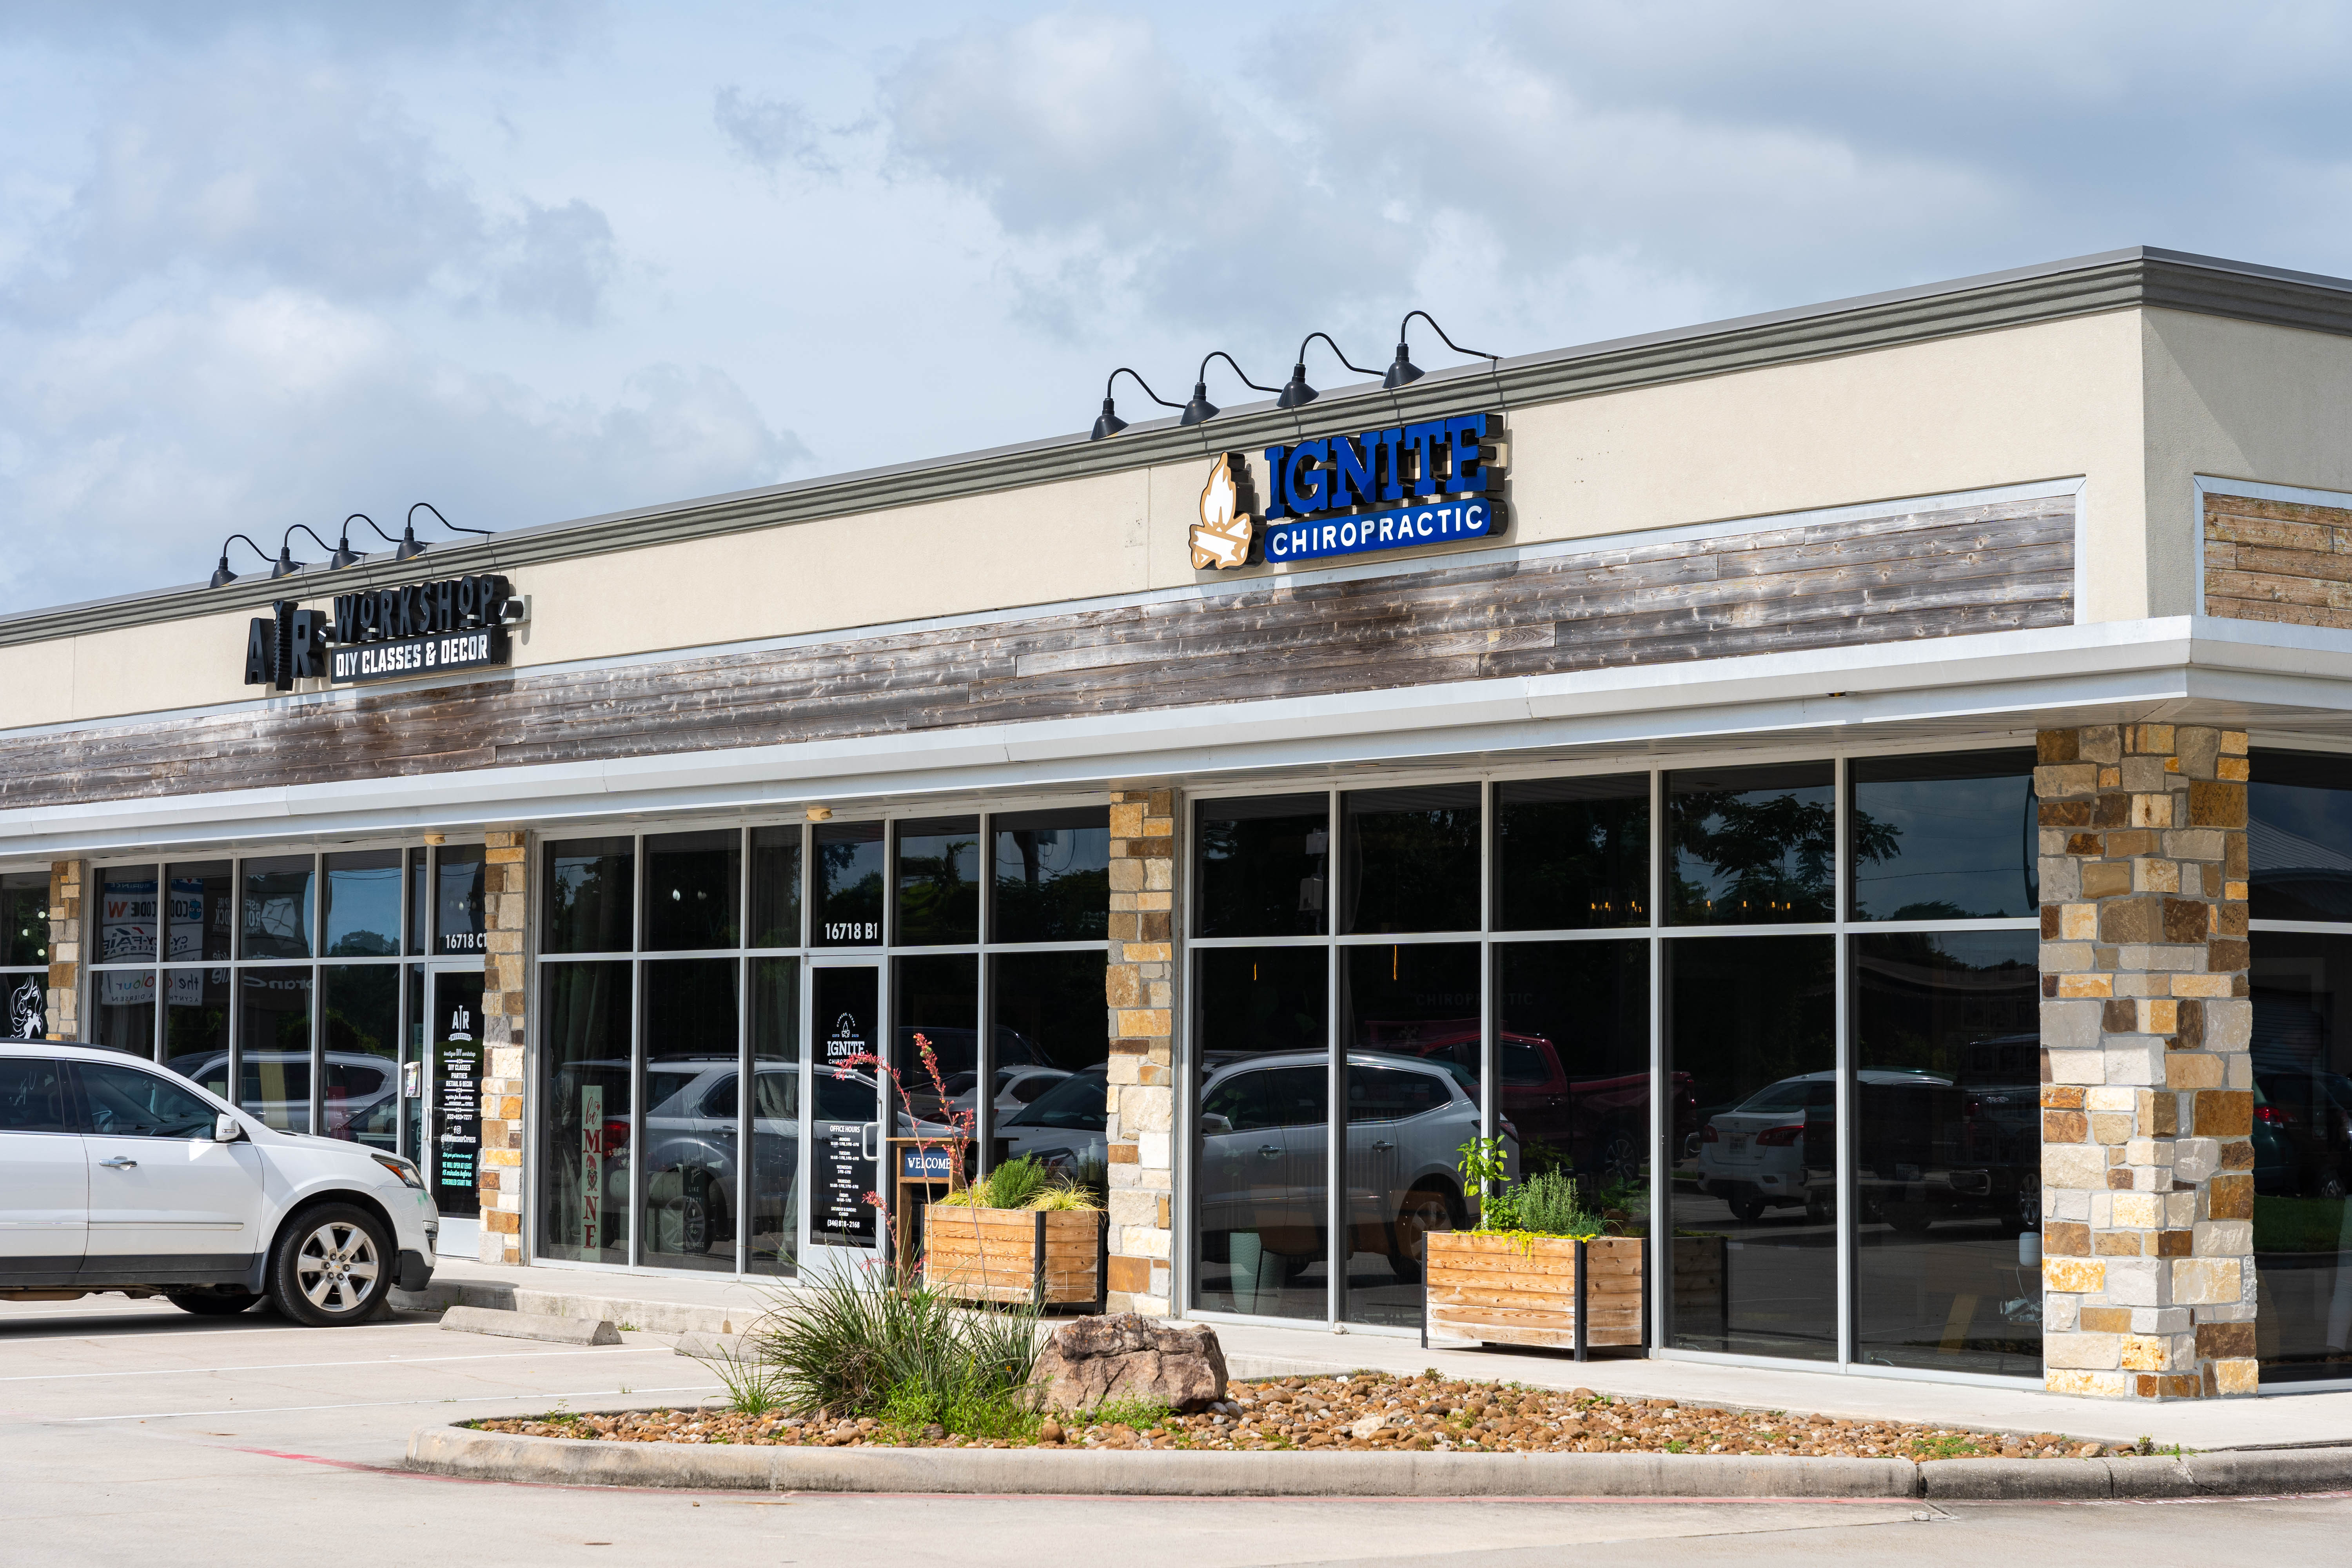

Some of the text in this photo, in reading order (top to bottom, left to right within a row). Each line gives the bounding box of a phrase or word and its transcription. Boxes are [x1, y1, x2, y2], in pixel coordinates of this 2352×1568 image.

[1265, 412, 1487, 520] IGNITE
[1273, 506, 1483, 555] CHIROPRACTIC
[334, 574, 495, 643] WORKSHOP
[336, 635, 487, 677] DIY CLASSES & DECOR
[826, 923, 877, 939] 16718 B1
[446, 934, 474, 948] 16718
[827, 1041, 865, 1056] IGNITE
[907, 1157, 950, 1169] WELCOME
[460, 1170, 472, 1179] before
